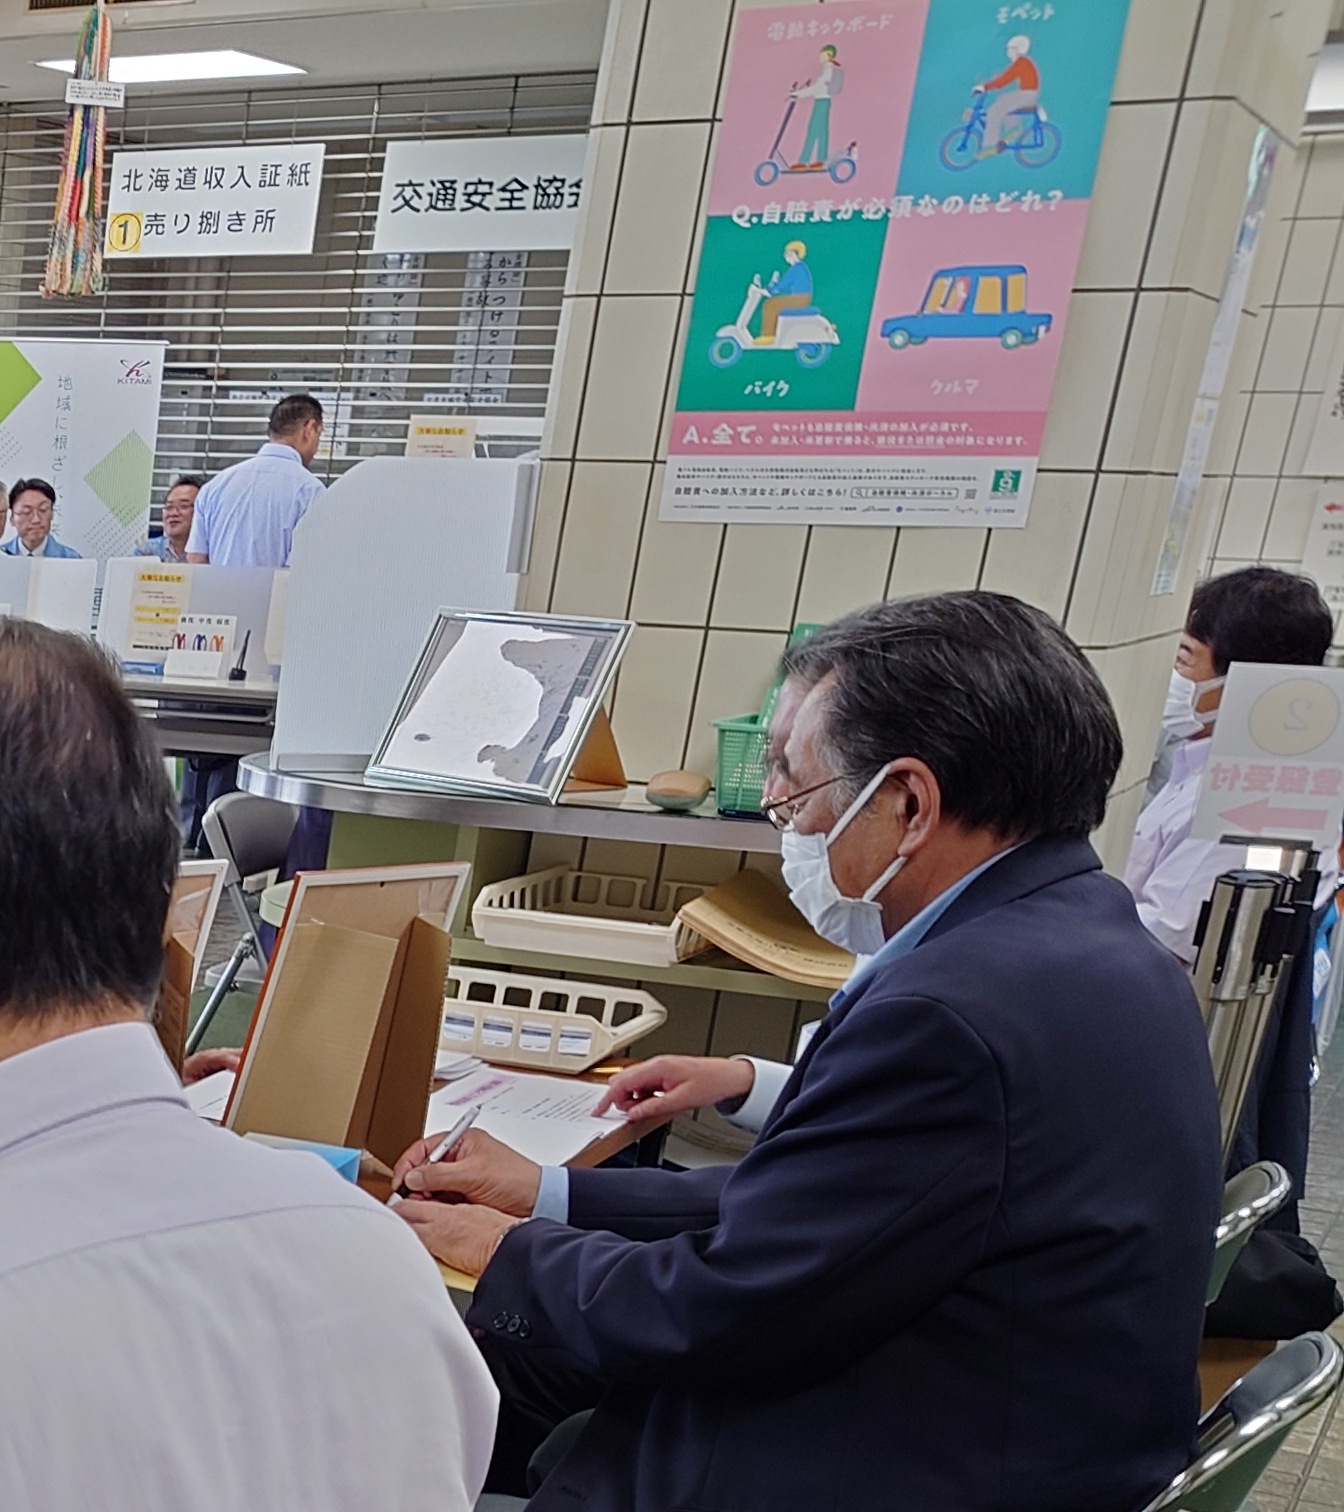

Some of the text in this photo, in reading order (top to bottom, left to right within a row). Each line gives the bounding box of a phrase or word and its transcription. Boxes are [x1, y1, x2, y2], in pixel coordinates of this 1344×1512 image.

[767, 14, 894, 41] 電動キックボード
[121, 162, 311, 193] 北海道収入証紙
[143, 208, 277, 236] 売り捌き所
[743, 379, 790, 398] バイク
[930, 378, 980, 396] クルマ
